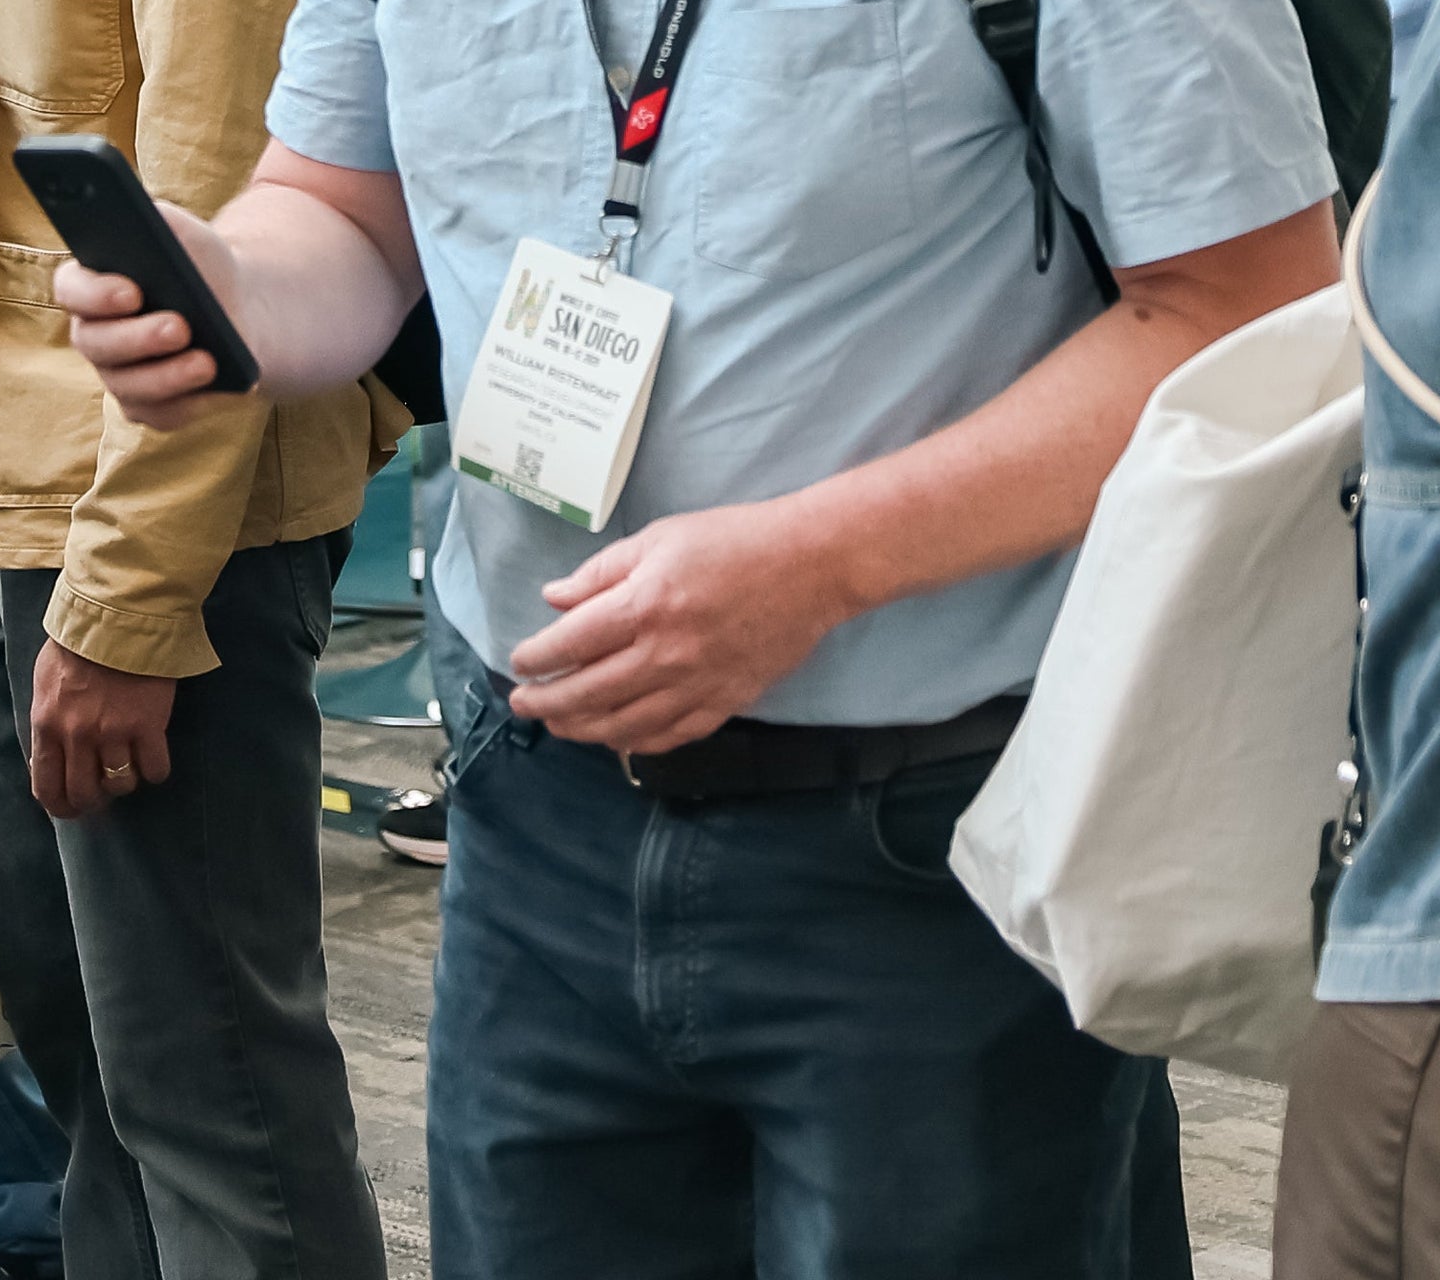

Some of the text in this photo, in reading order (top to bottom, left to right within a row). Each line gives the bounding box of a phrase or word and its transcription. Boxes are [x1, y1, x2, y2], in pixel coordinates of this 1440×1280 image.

[493, 342, 547, 374] WILLIAM
[548, 306, 640, 365] SAN DIEGO
